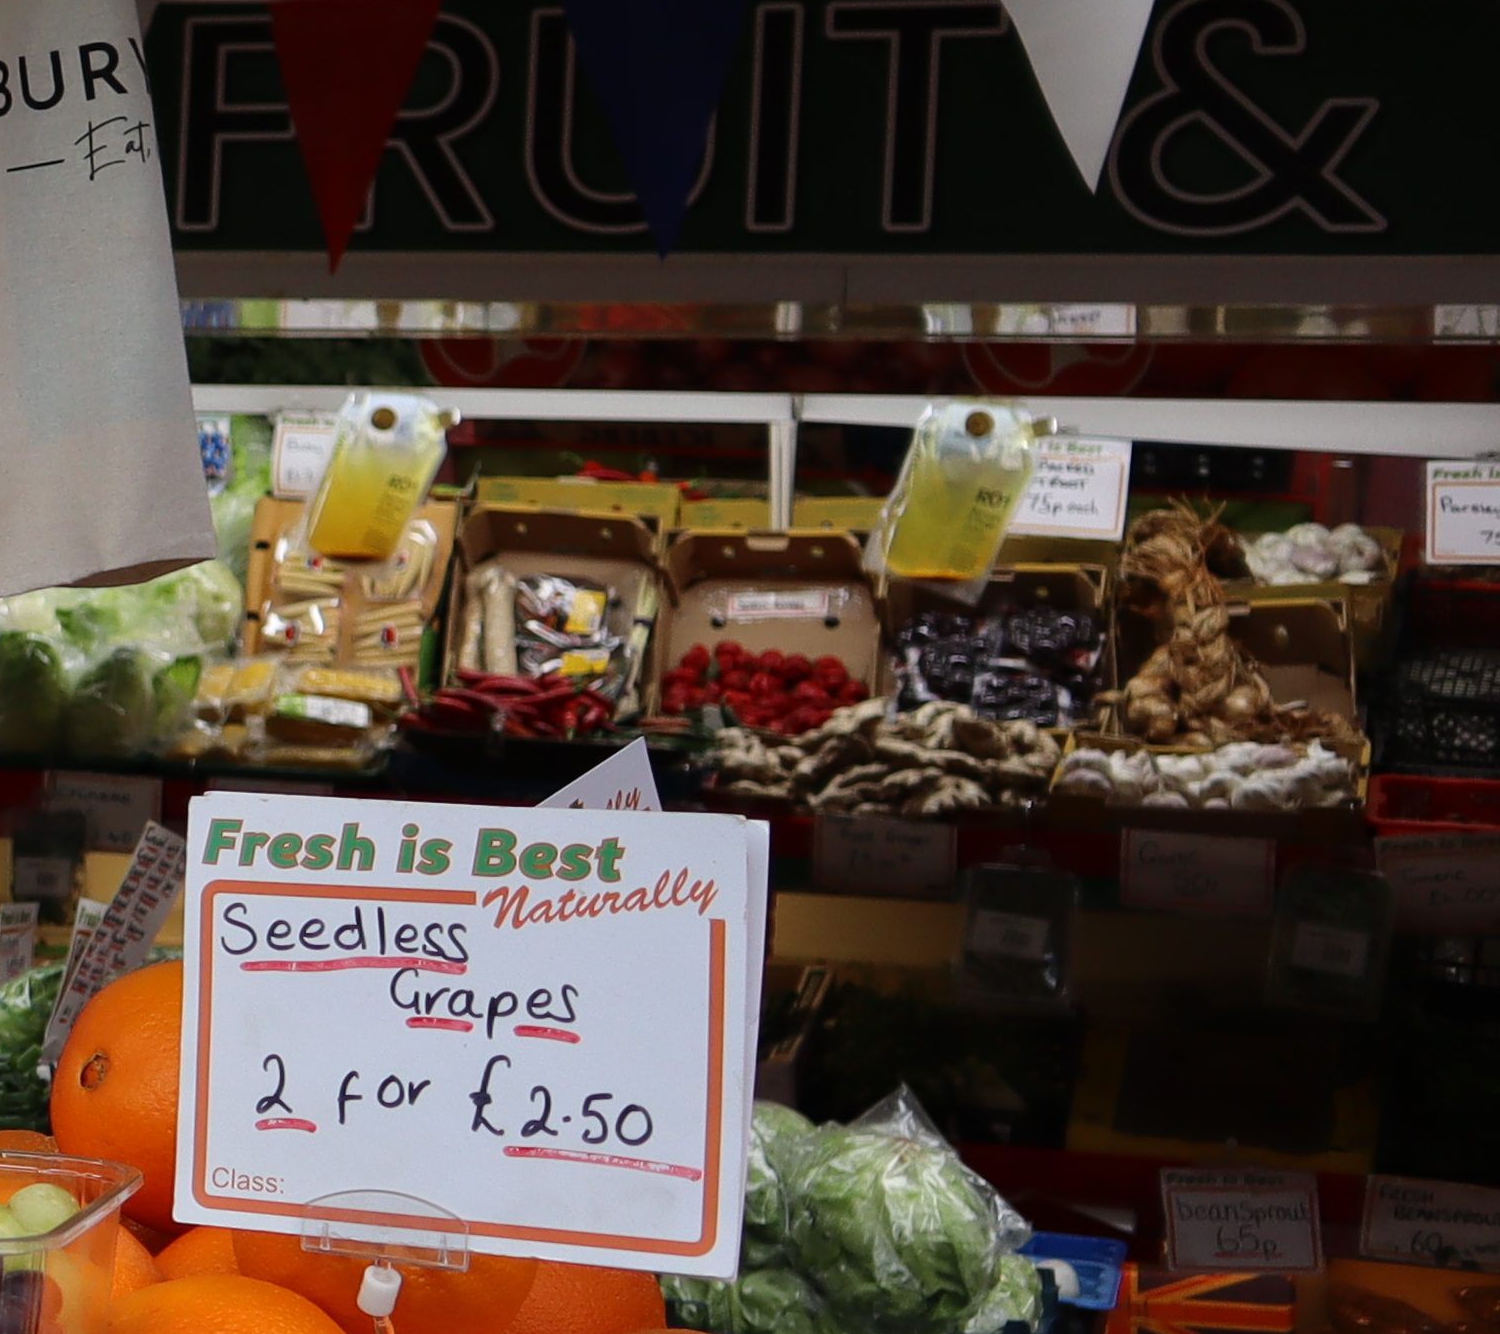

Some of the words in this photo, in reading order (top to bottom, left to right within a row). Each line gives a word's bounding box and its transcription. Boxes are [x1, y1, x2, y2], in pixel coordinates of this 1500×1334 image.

[174, 0, 1010, 235] FRUIT
[200, 817, 376, 871] Fresh
[395, 822, 452, 875] is
[470, 827, 627, 883] Best
[481, 867, 720, 930] Naturally
[220, 901, 469, 963] Seedless
[389, 966, 581, 1040] Grapes
[255, 1053, 295, 1116] 2
[336, 1068, 432, 1124] for
[469, 1053, 654, 1147] £2.50
[211, 1166, 287, 1196] Class:
